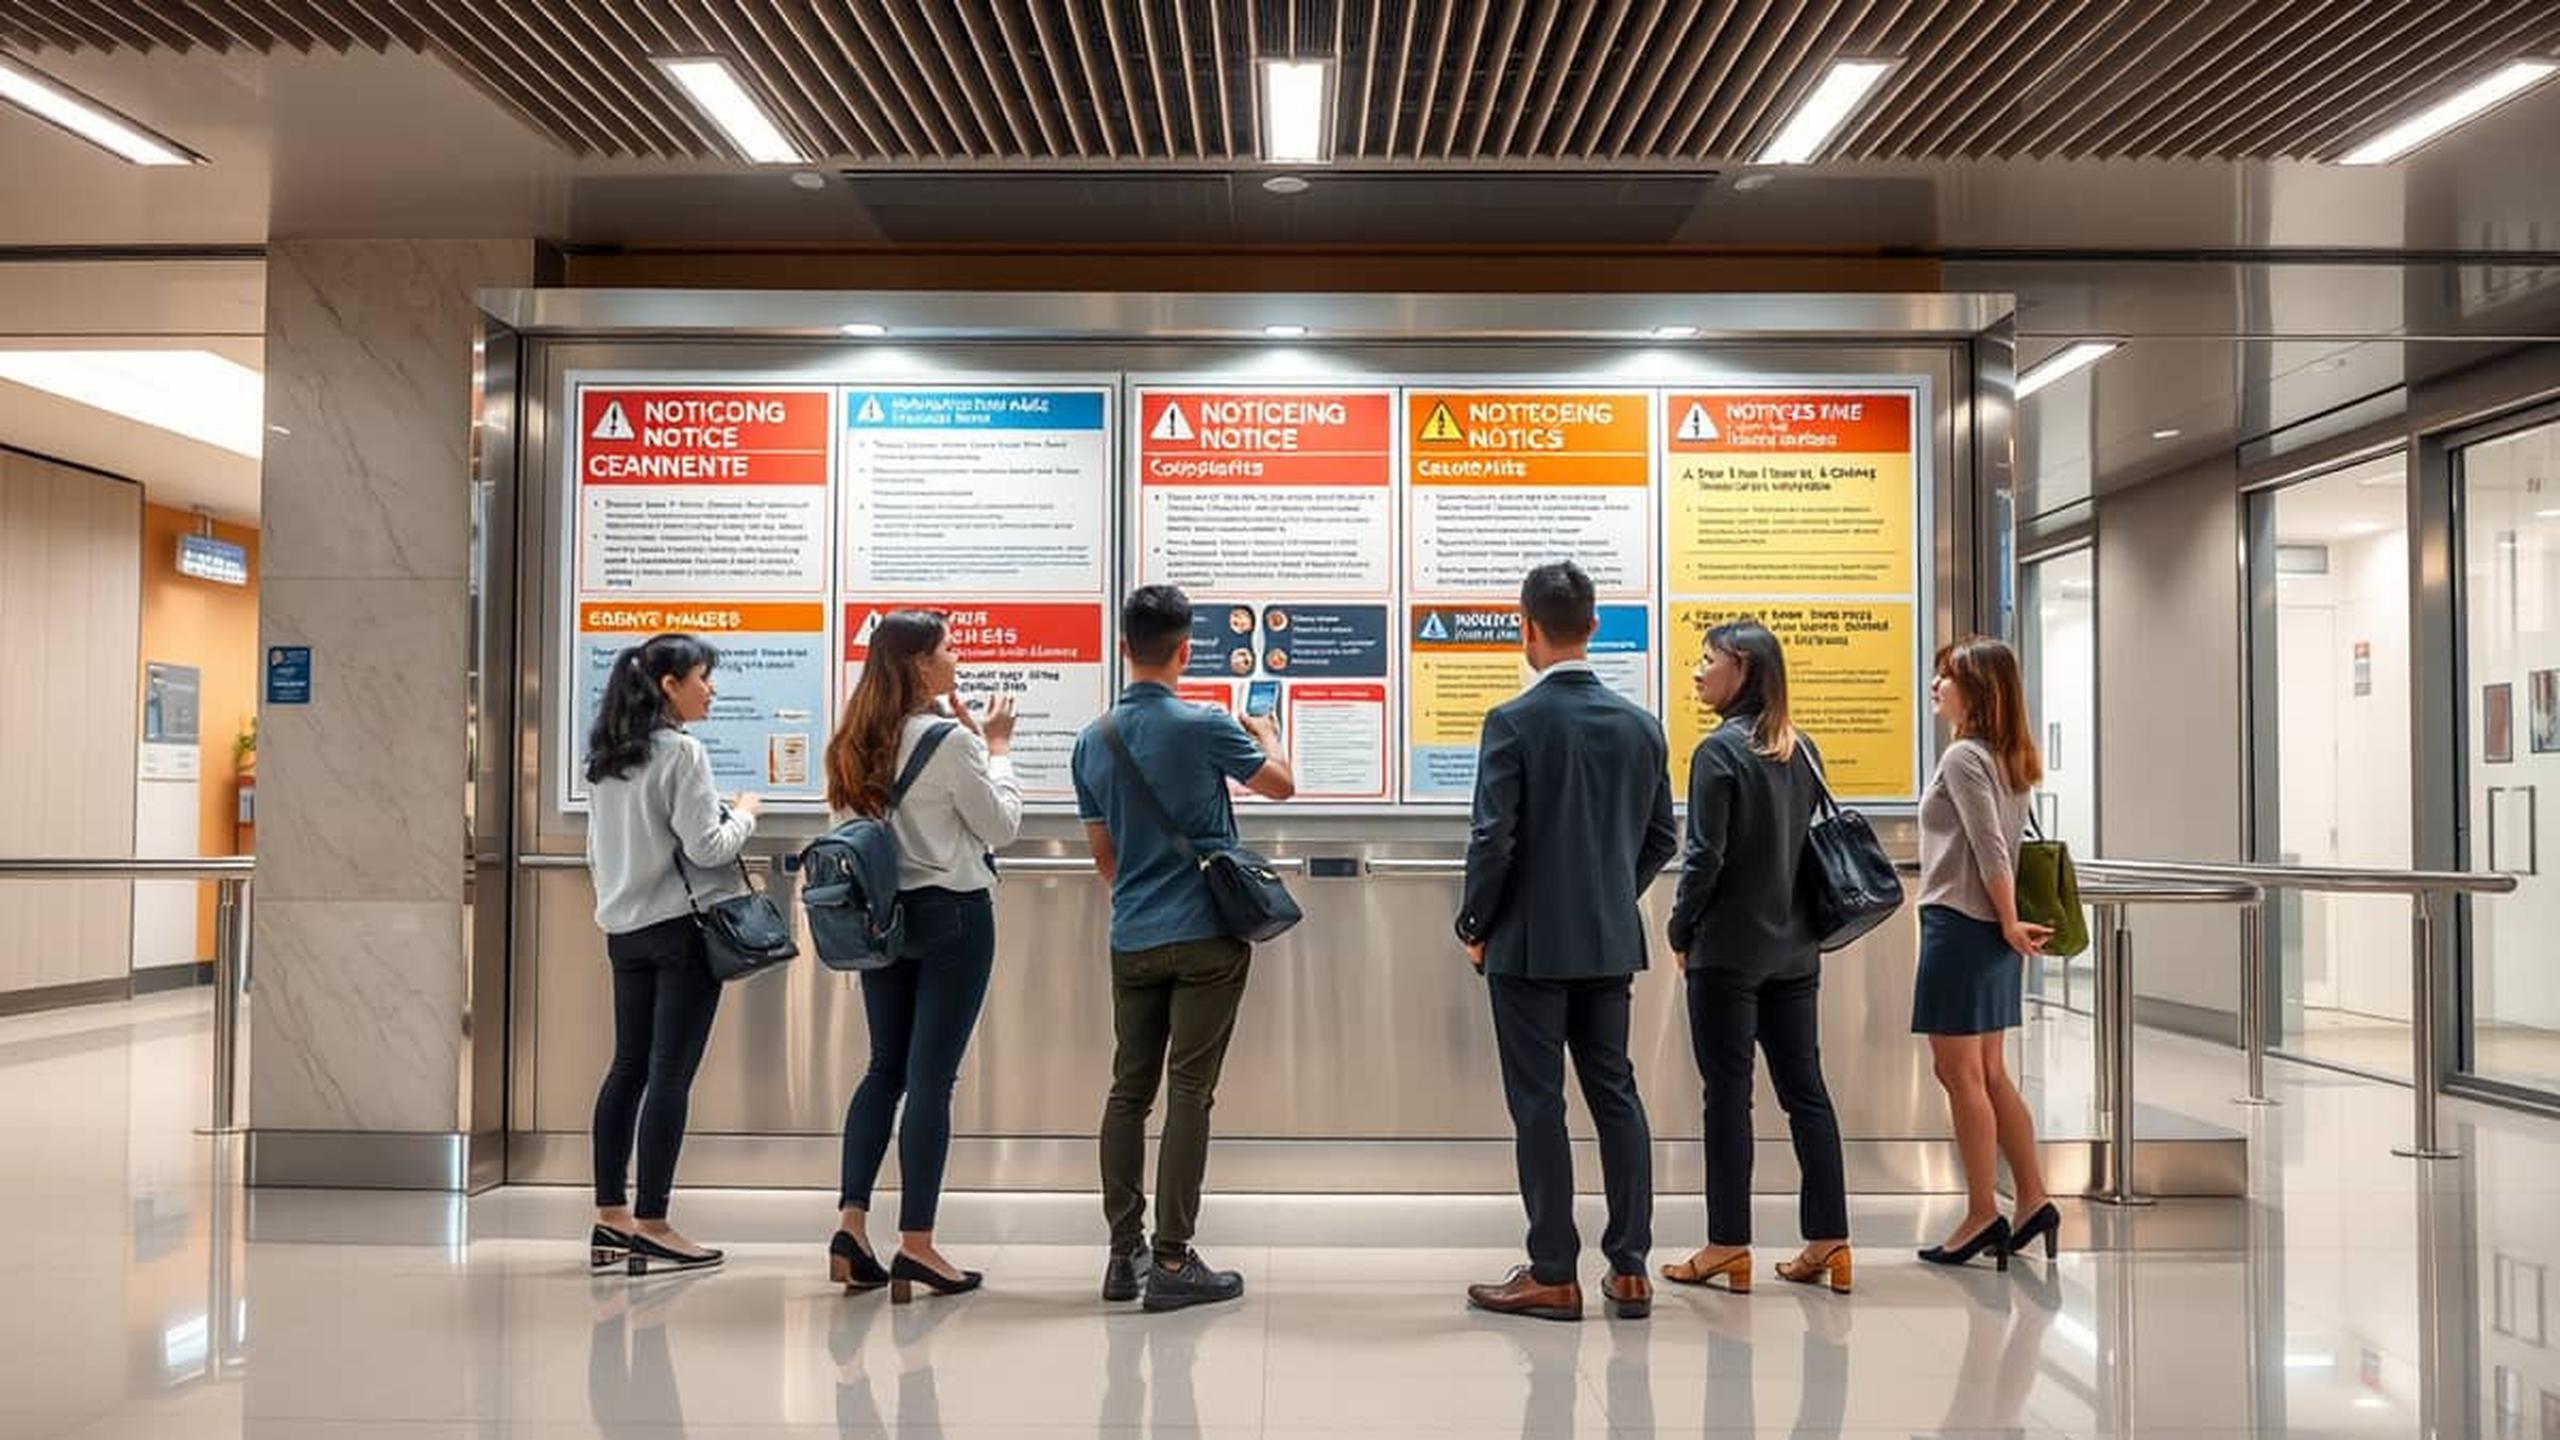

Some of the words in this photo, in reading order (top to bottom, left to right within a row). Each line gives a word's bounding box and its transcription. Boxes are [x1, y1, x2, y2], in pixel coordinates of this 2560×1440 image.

[1201, 402, 1346, 425] NOTICEING
[644, 427, 738, 448] NOTICE
[1201, 429, 1299, 449] NOTICE
